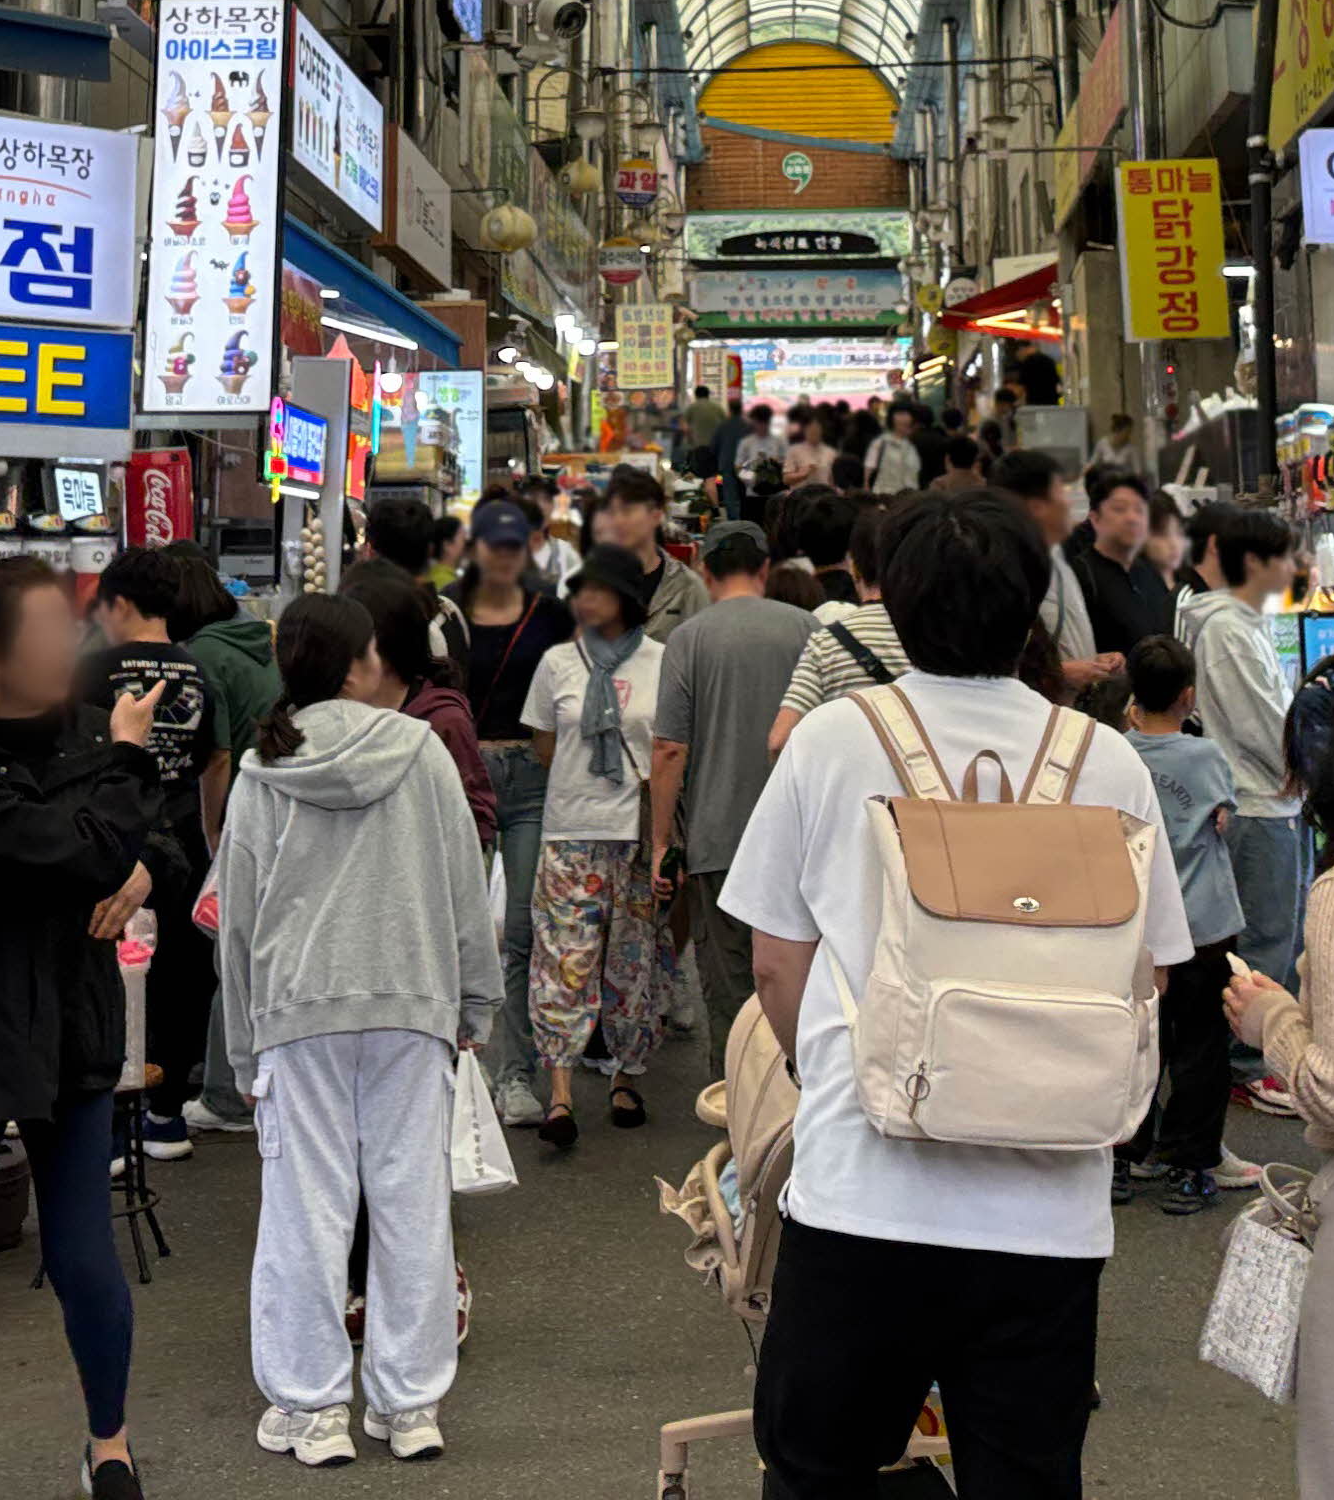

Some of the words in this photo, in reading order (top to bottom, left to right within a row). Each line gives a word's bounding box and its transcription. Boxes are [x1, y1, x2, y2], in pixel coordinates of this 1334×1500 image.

[165, 6, 280, 35] 상하목장
[165, 38, 277, 60] 아이스크림
[299, 32, 330, 102] COFFEE
[617, 170, 657, 191] 과일
[1127, 167, 1213, 195] 통마늘
[1152, 199, 1199, 333] 닭강정
